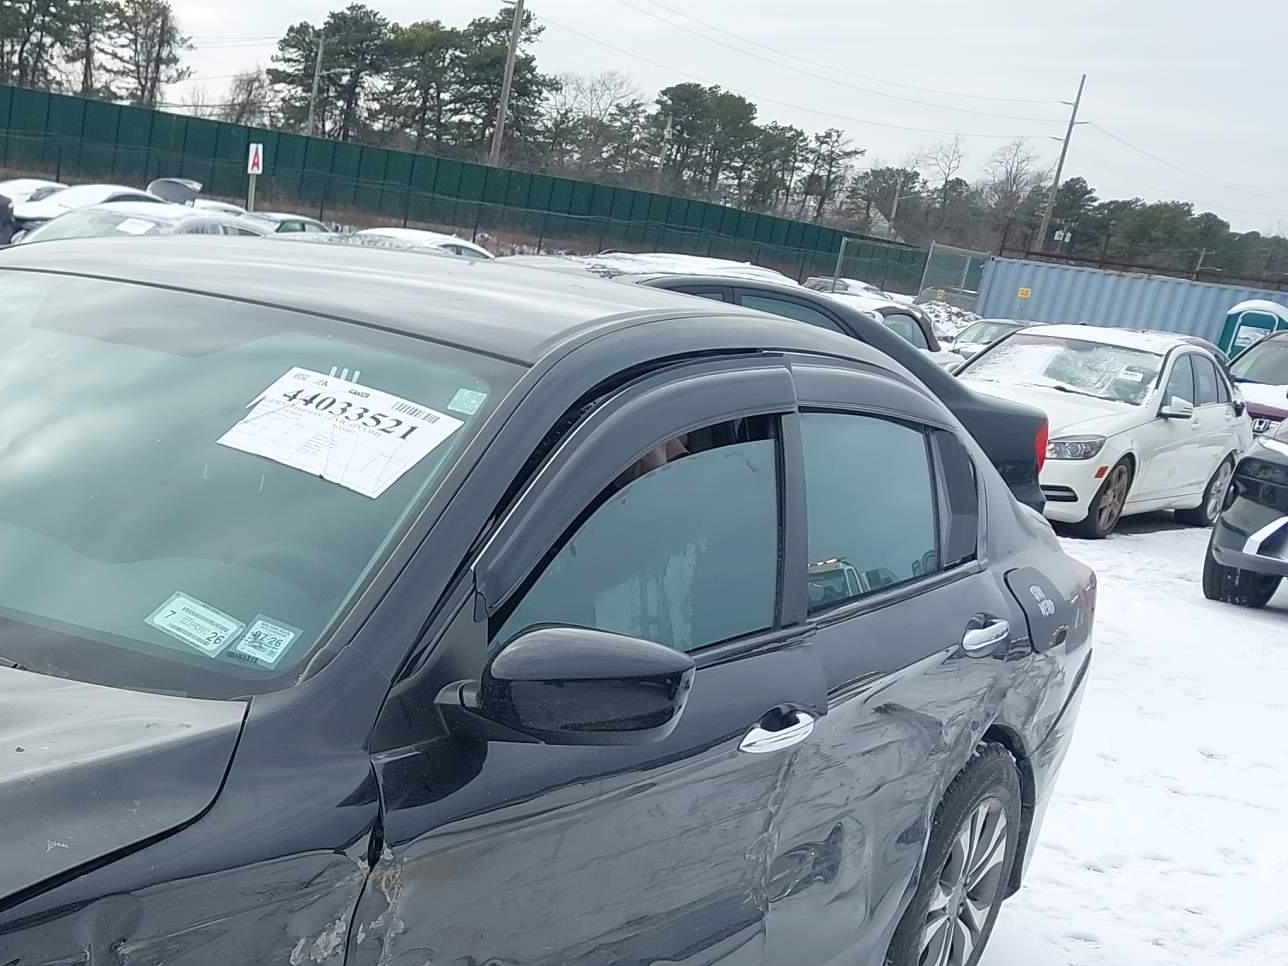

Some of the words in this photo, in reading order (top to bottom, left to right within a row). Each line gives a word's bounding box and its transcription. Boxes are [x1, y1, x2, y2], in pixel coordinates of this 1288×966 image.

[251, 144, 260, 171] A
[283, 388, 418, 440] 44033521
[206, 631, 226, 645] 26
